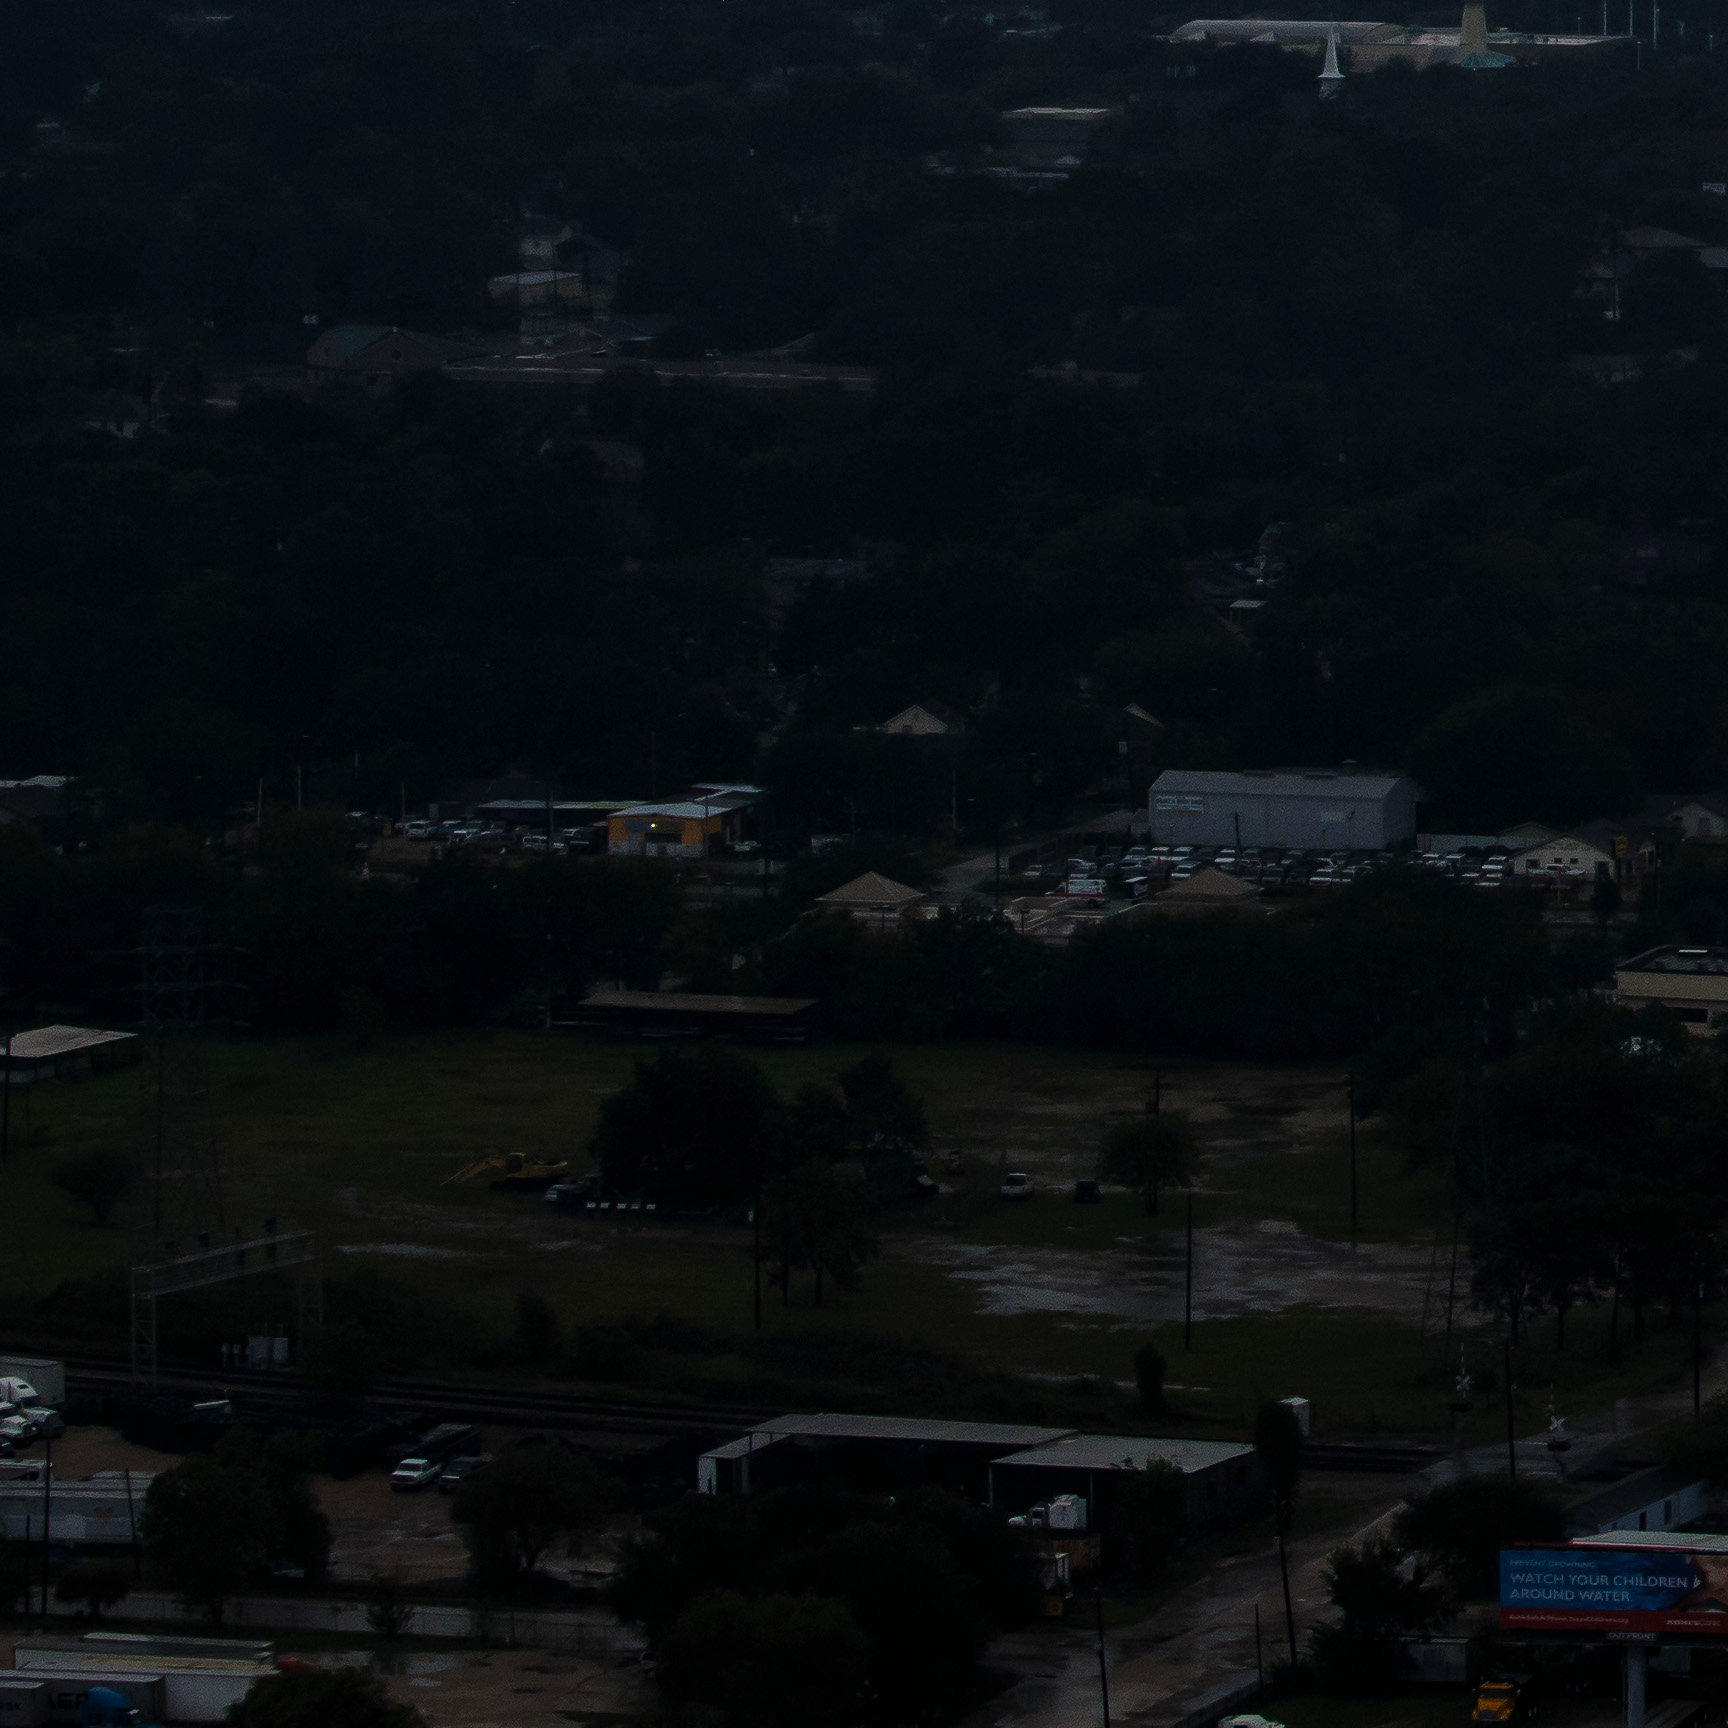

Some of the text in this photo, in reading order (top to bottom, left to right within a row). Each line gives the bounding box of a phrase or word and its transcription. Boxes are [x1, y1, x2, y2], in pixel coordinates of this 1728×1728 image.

[1510, 1573, 1689, 1588] WATCH YOUR CHILDREN
[1509, 1588, 1633, 1602] AROUND WATER.
